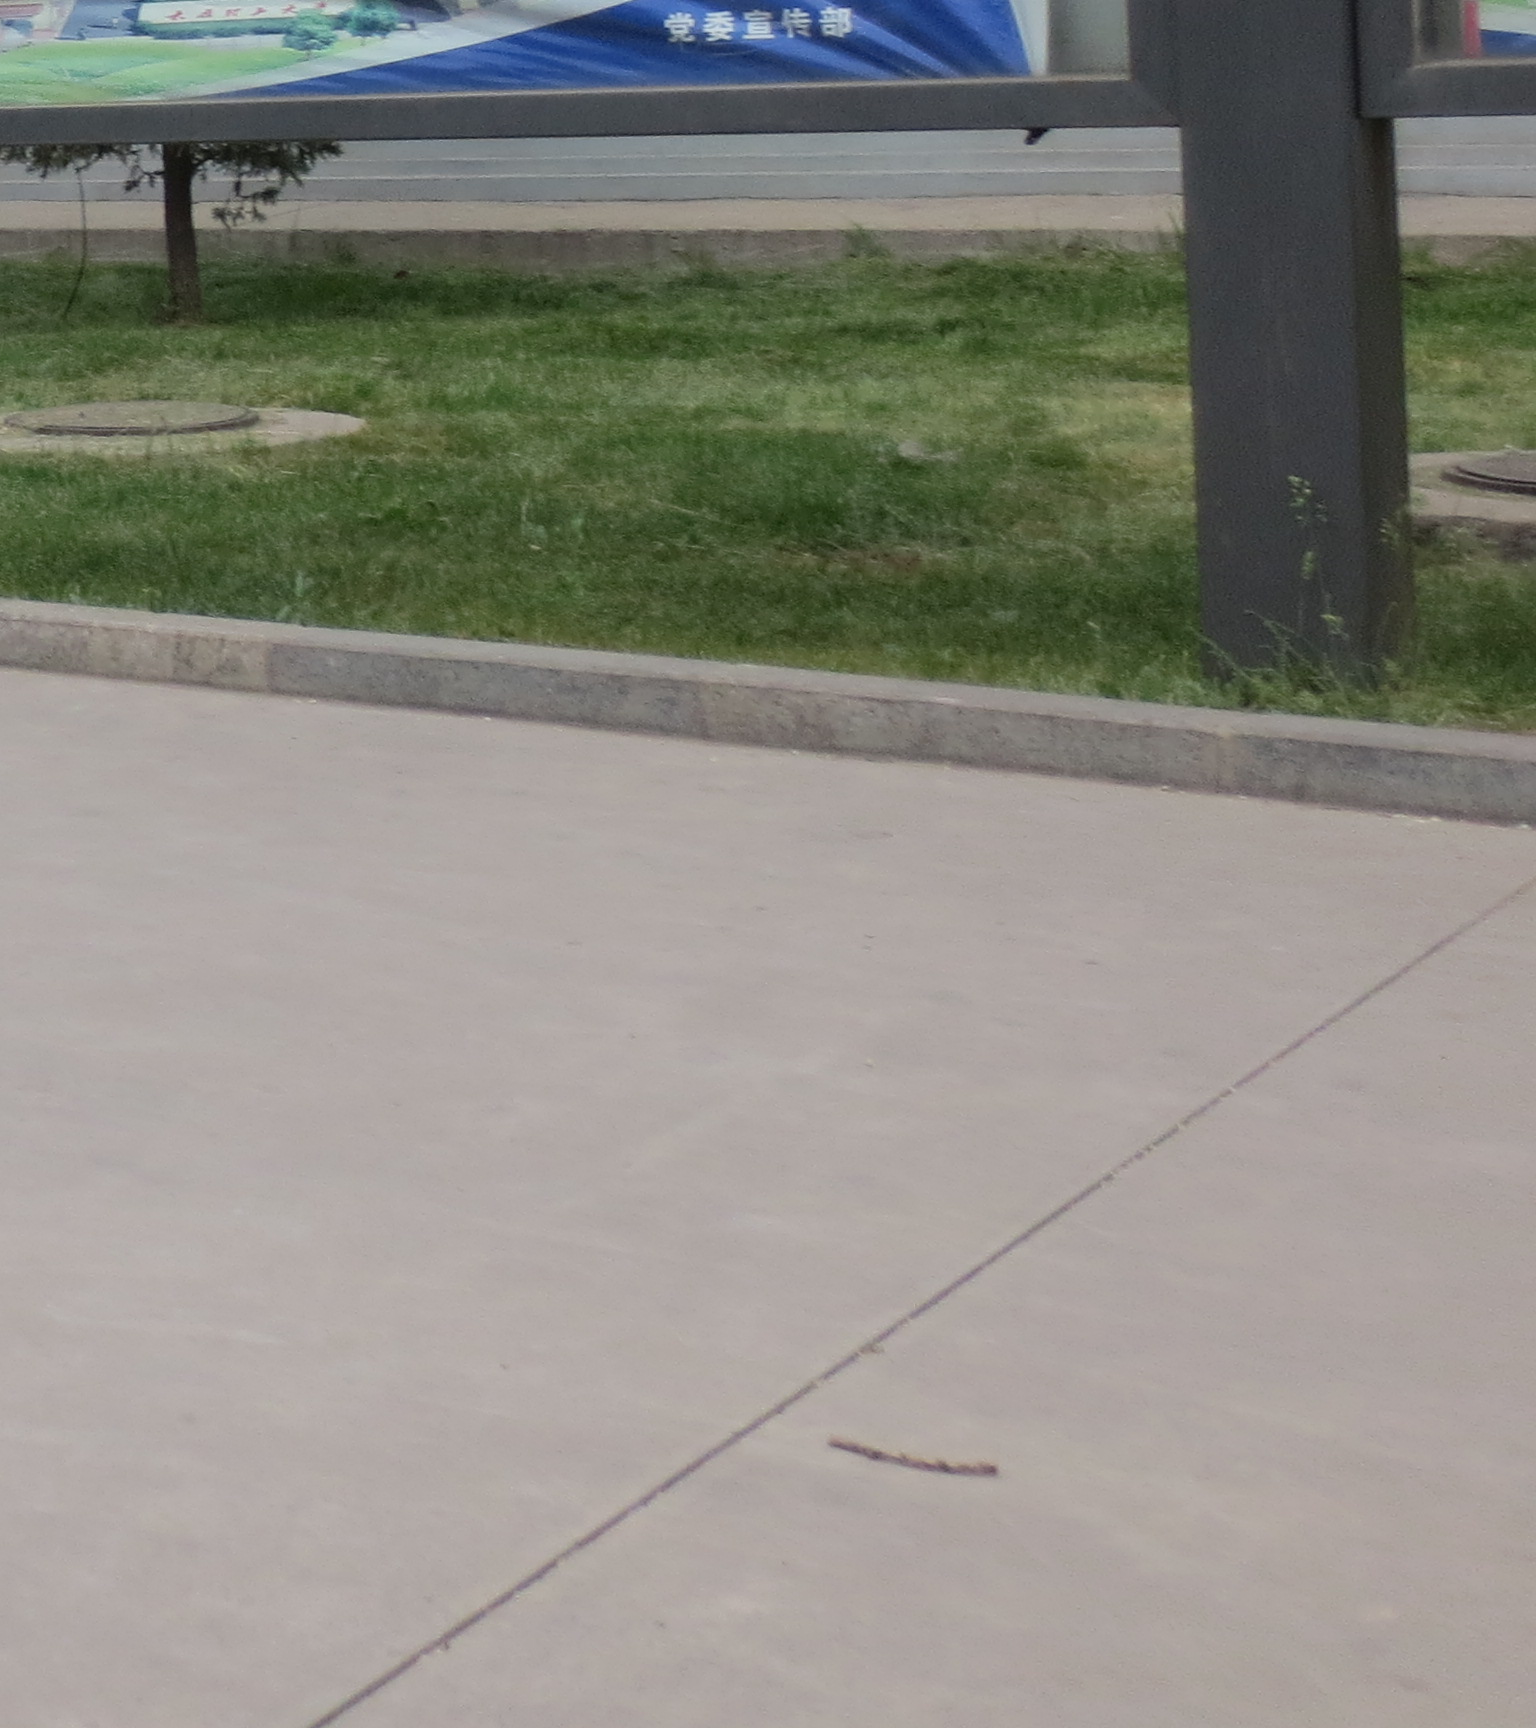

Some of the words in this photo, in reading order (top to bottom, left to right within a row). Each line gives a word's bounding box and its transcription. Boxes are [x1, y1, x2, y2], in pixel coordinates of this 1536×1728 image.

[664, 7, 854, 43] 党委宣传部
